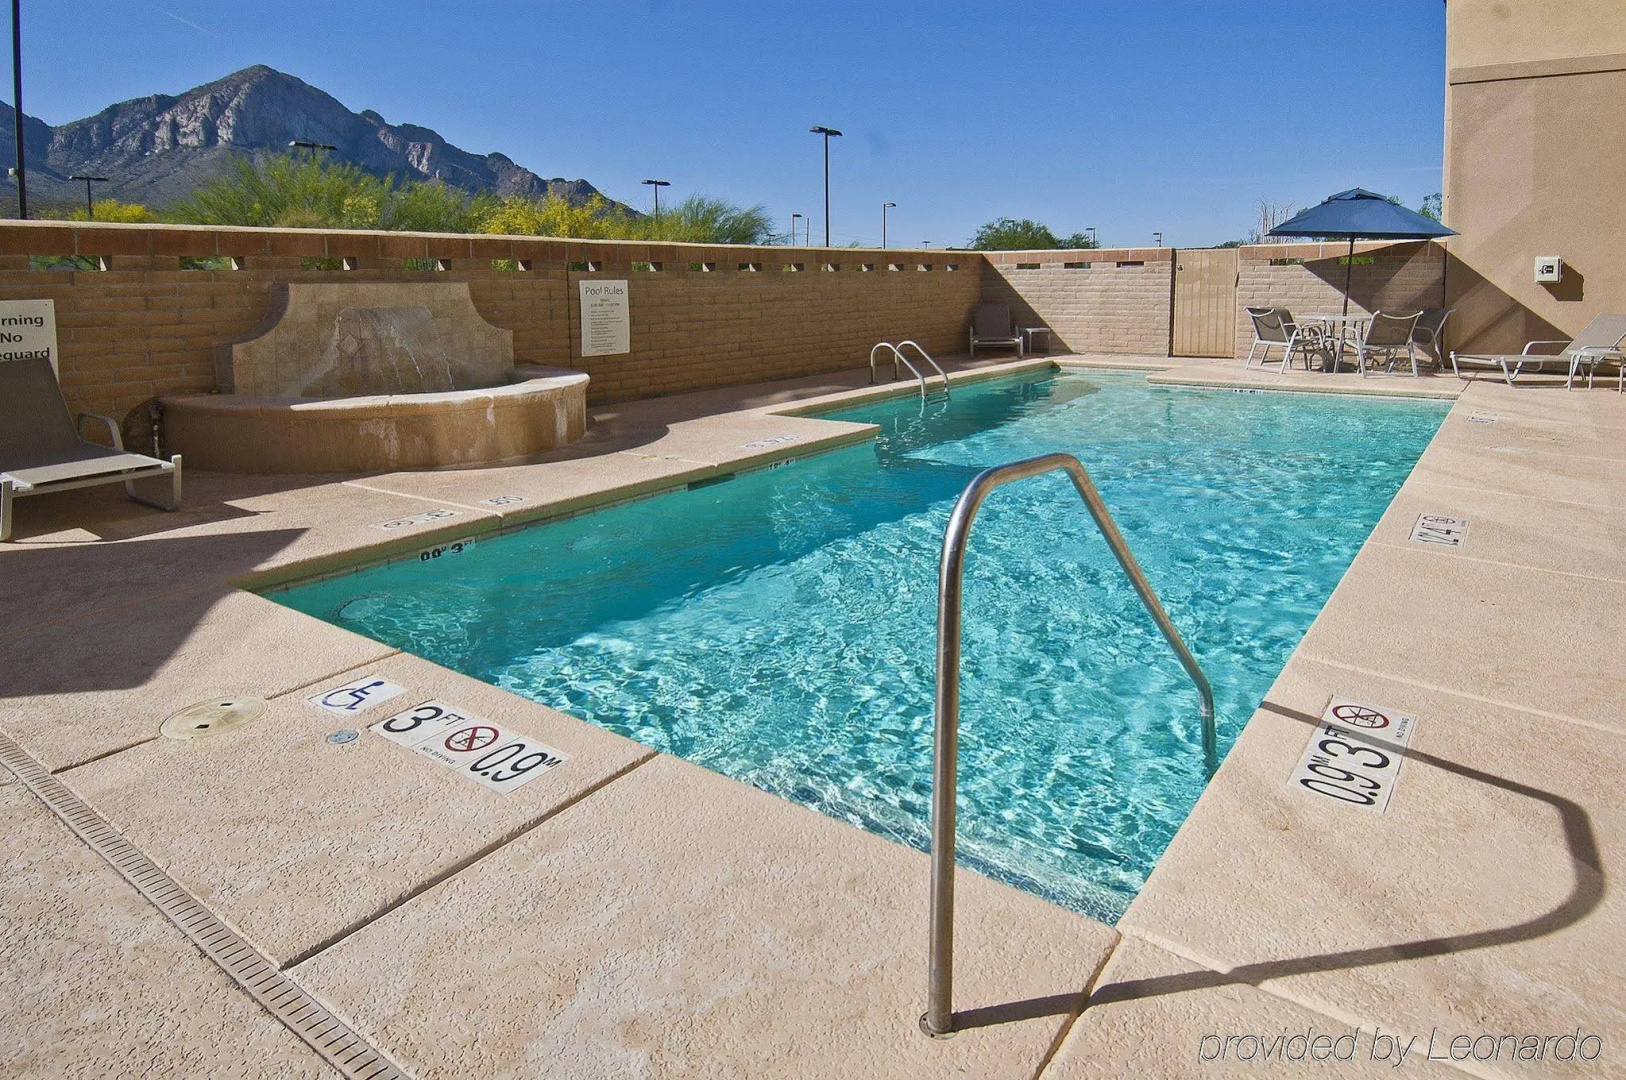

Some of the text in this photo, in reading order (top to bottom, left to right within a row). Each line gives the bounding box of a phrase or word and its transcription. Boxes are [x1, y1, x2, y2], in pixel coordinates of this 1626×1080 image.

[585, 286, 623, 295] Pool Rules
[1, 314, 43, 327] rning
[0, 332, 23, 343] No
